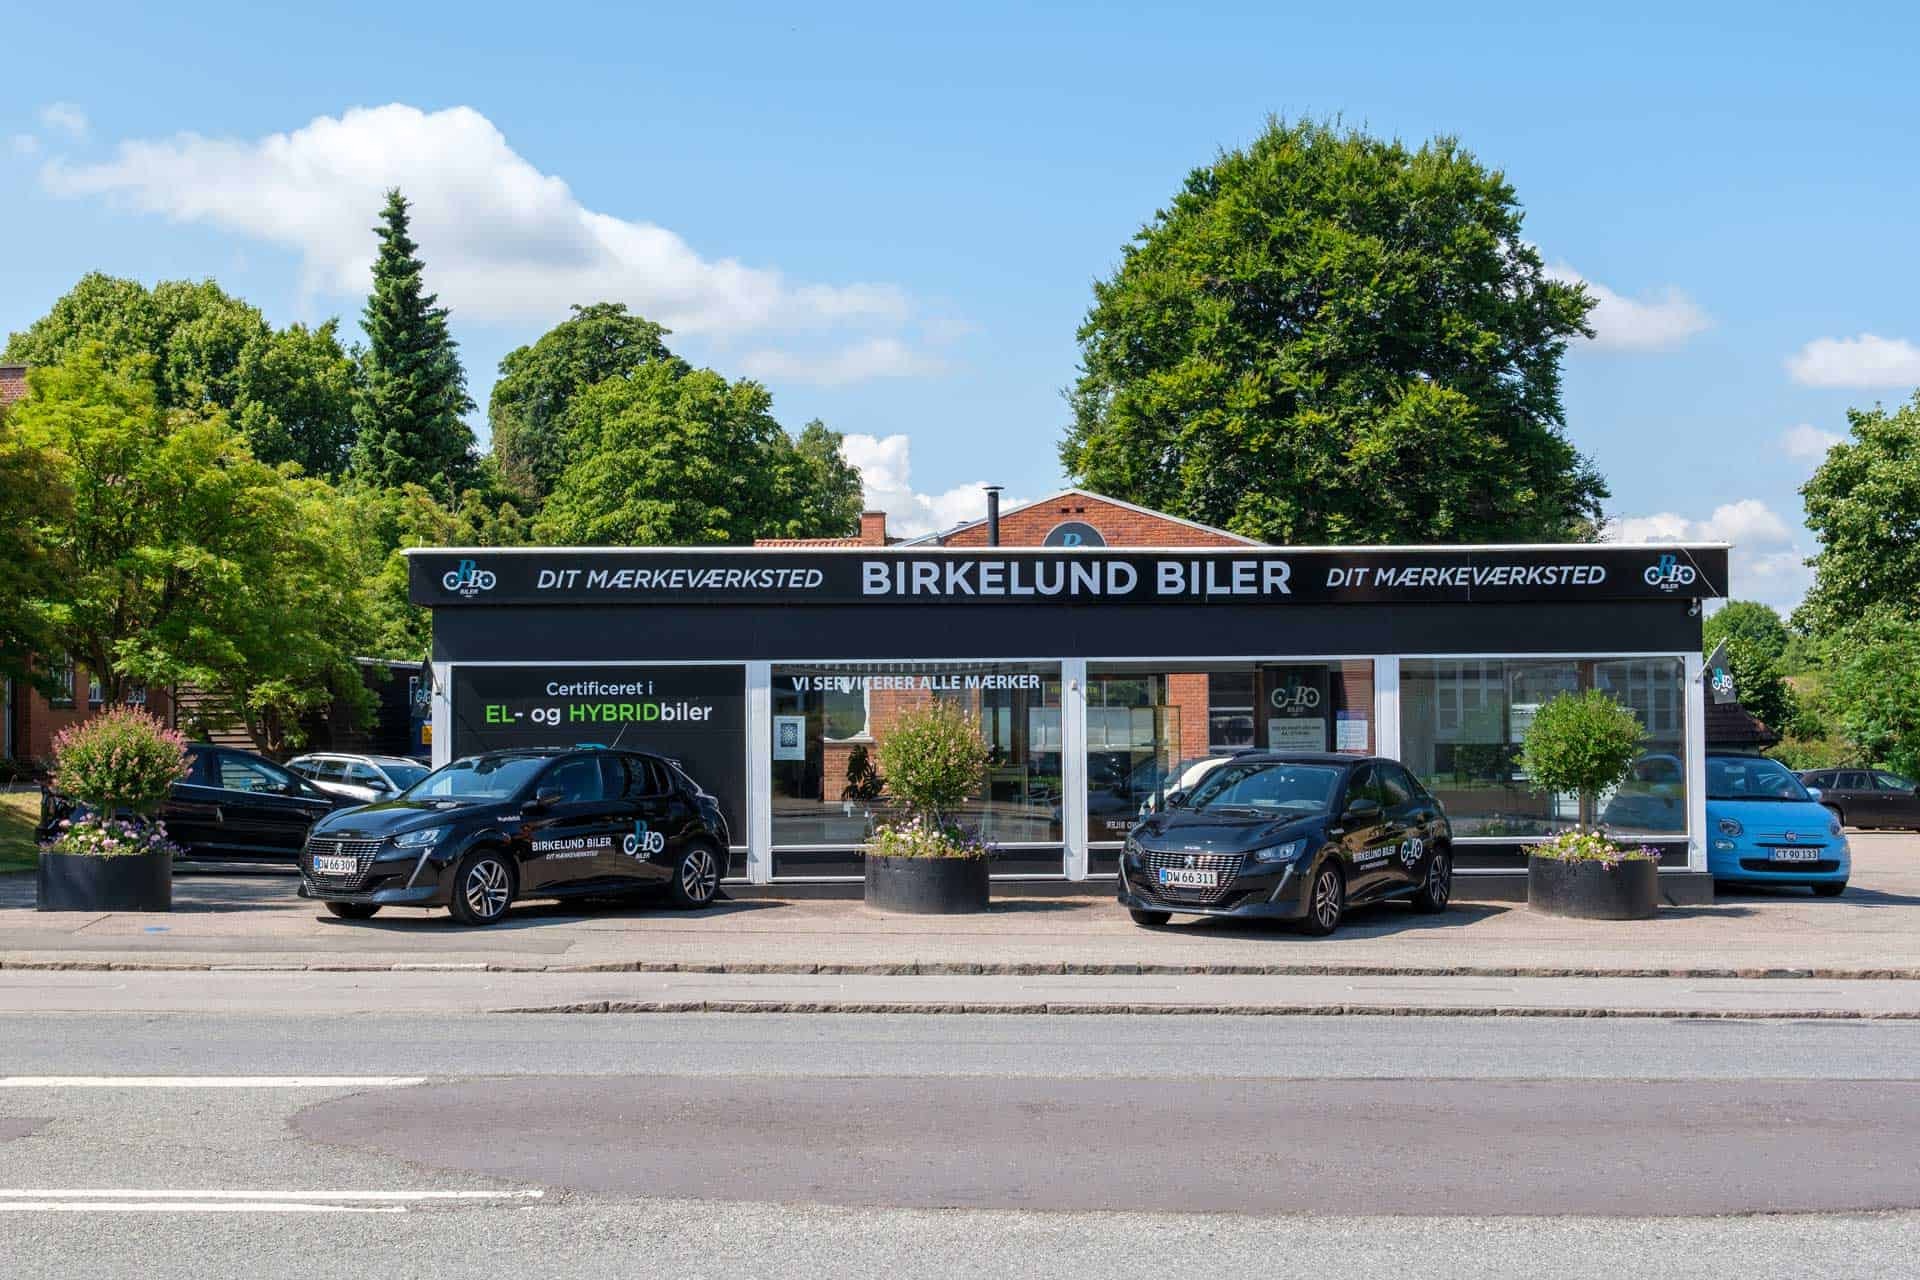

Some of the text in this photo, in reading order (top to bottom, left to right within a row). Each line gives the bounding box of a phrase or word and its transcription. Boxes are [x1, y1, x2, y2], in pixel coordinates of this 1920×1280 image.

[536, 568, 825, 589] DIT MÆRKEVÆRKSTED
[861, 560, 1293, 596] BIRKELUND BILER
[1326, 565, 1607, 588] DIT MÆRKEVÆRKSTED
[545, 681, 654, 697] Certificeret i
[792, 674, 1041, 691] VI SERVICERER ALLE MÆRKER
[485, 702, 714, 726] EL- og HYBRIDbiler
[531, 836, 612, 852] BIRKELUND BILER
[1776, 850, 1817, 859] CT 90 133
[1166, 871, 1214, 884] DW 66 311
